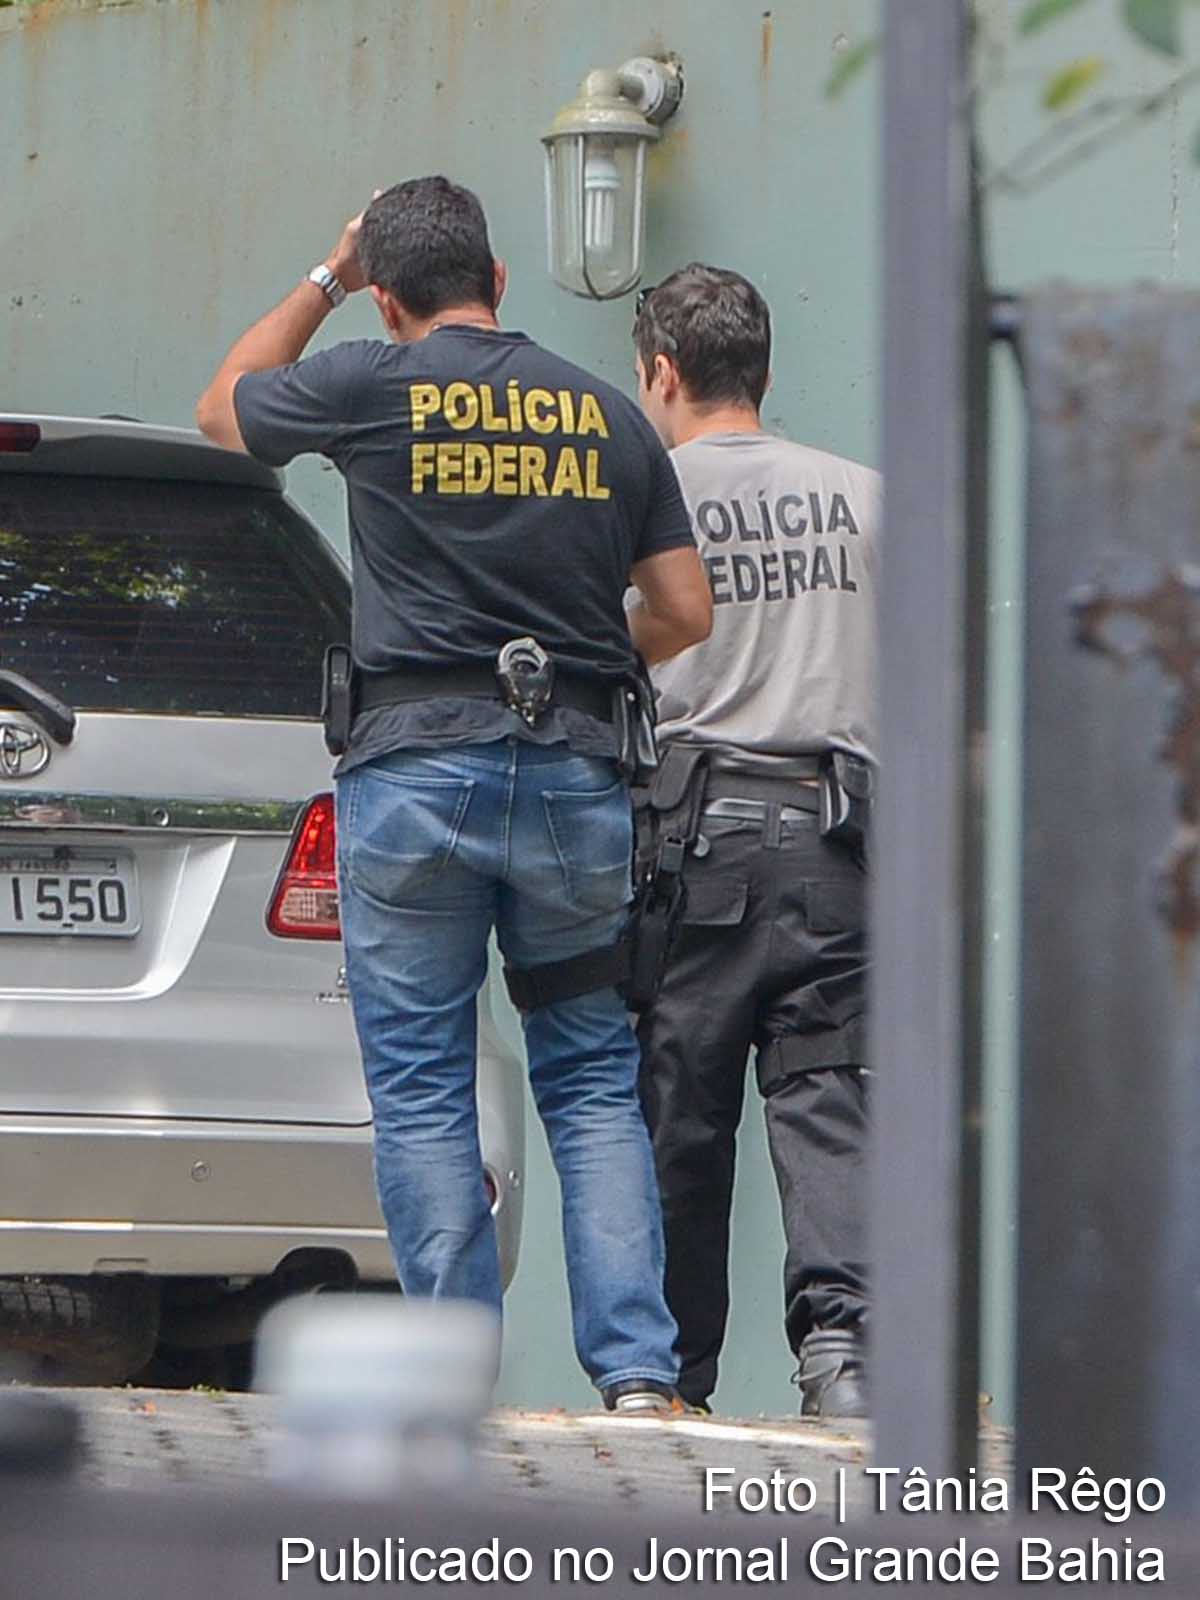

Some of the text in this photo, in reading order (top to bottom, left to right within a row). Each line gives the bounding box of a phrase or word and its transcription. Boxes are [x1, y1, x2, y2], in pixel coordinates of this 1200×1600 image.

[408, 379, 609, 438] POLÍCIA
[410, 443, 611, 499] FEDERAL
[696, 489, 859, 544] OLÍCIA
[704, 544, 858, 605] EDERAL
